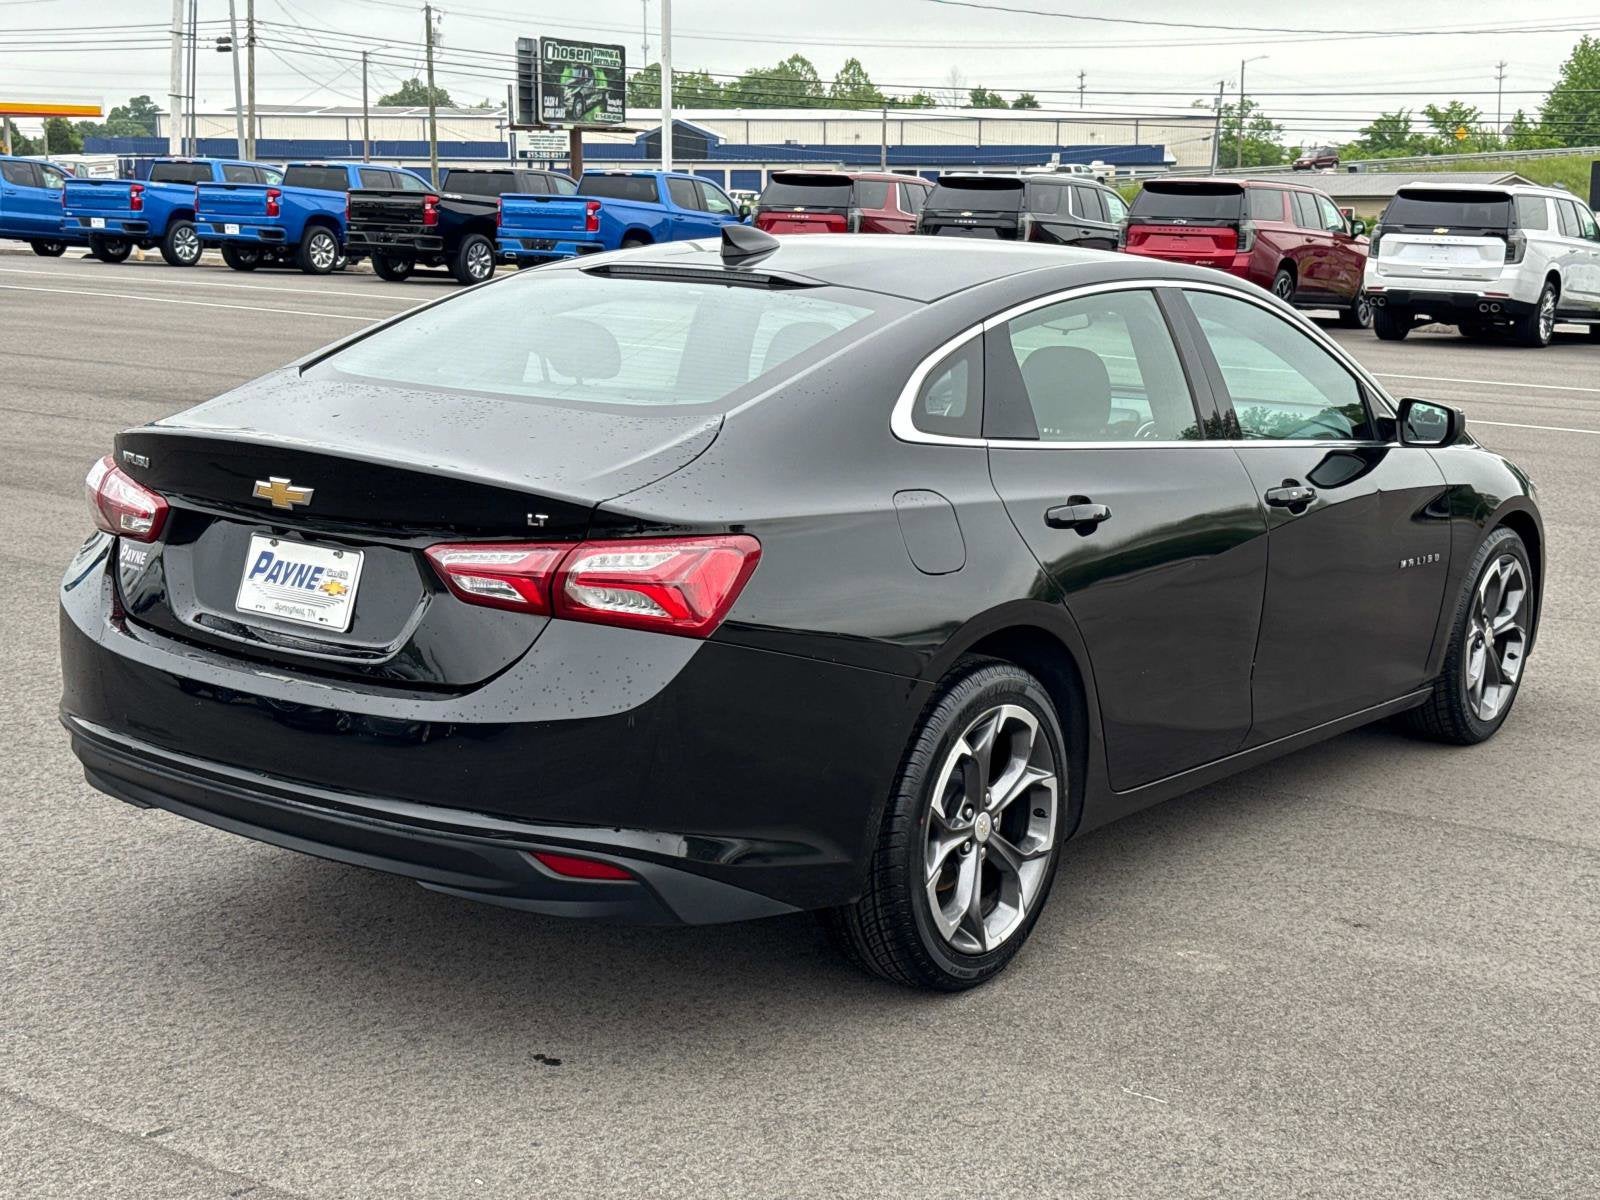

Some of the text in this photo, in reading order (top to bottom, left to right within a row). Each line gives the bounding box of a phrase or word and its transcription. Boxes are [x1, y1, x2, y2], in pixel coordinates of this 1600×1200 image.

[544, 41, 592, 64] Chosen
[527, 513, 549, 527] LT
[119, 544, 148, 565] PAYNE
[1400, 553, 1440, 569] MALIBU
[248, 551, 325, 590] PAYNE
[307, 608, 317, 618] TN
